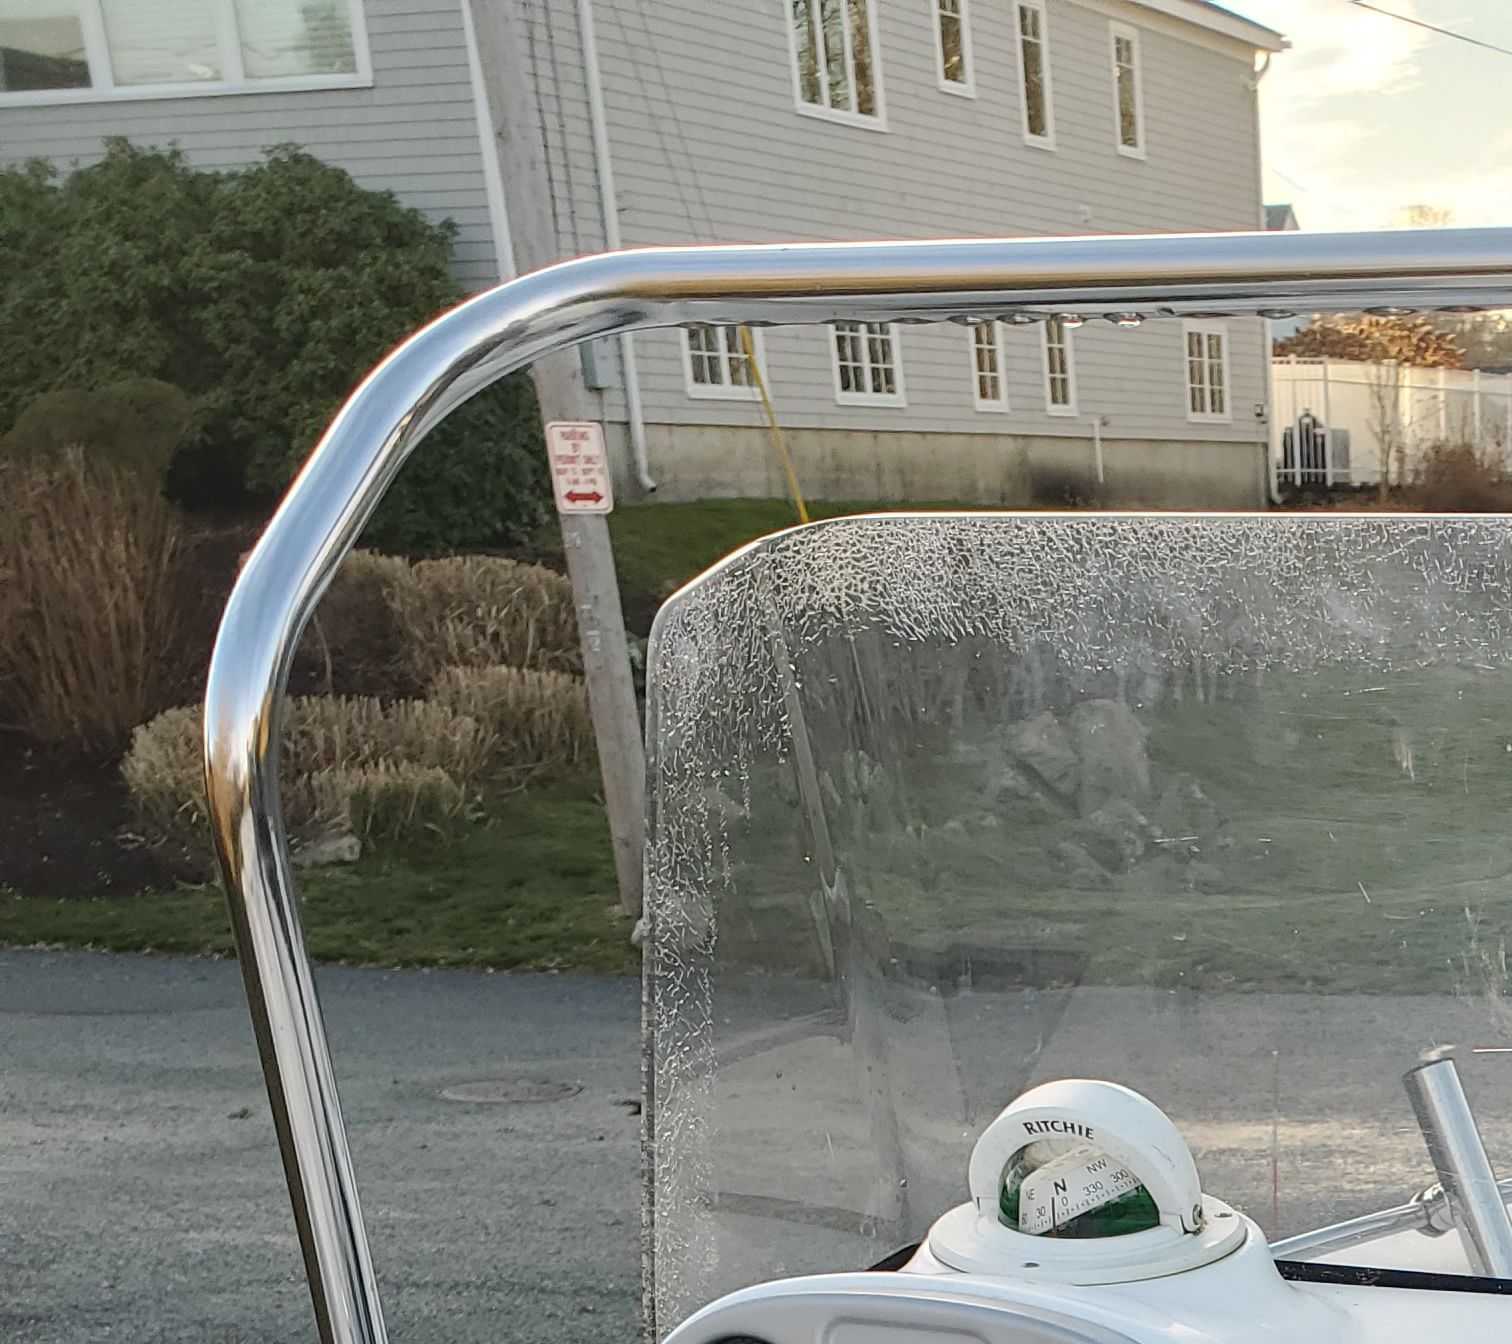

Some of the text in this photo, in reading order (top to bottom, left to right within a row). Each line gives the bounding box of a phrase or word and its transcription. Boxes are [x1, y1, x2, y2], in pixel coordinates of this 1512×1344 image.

[1022, 1120, 1095, 1140] RITCHIE
[1086, 1159, 1107, 1174] NW
[1110, 1169, 1129, 1183] 300
[1053, 1178, 1067, 1195] N
[1082, 1181, 1104, 1196] 330
[1061, 1196, 1068, 1207] 0
[1036, 1206, 1046, 1218] 30
